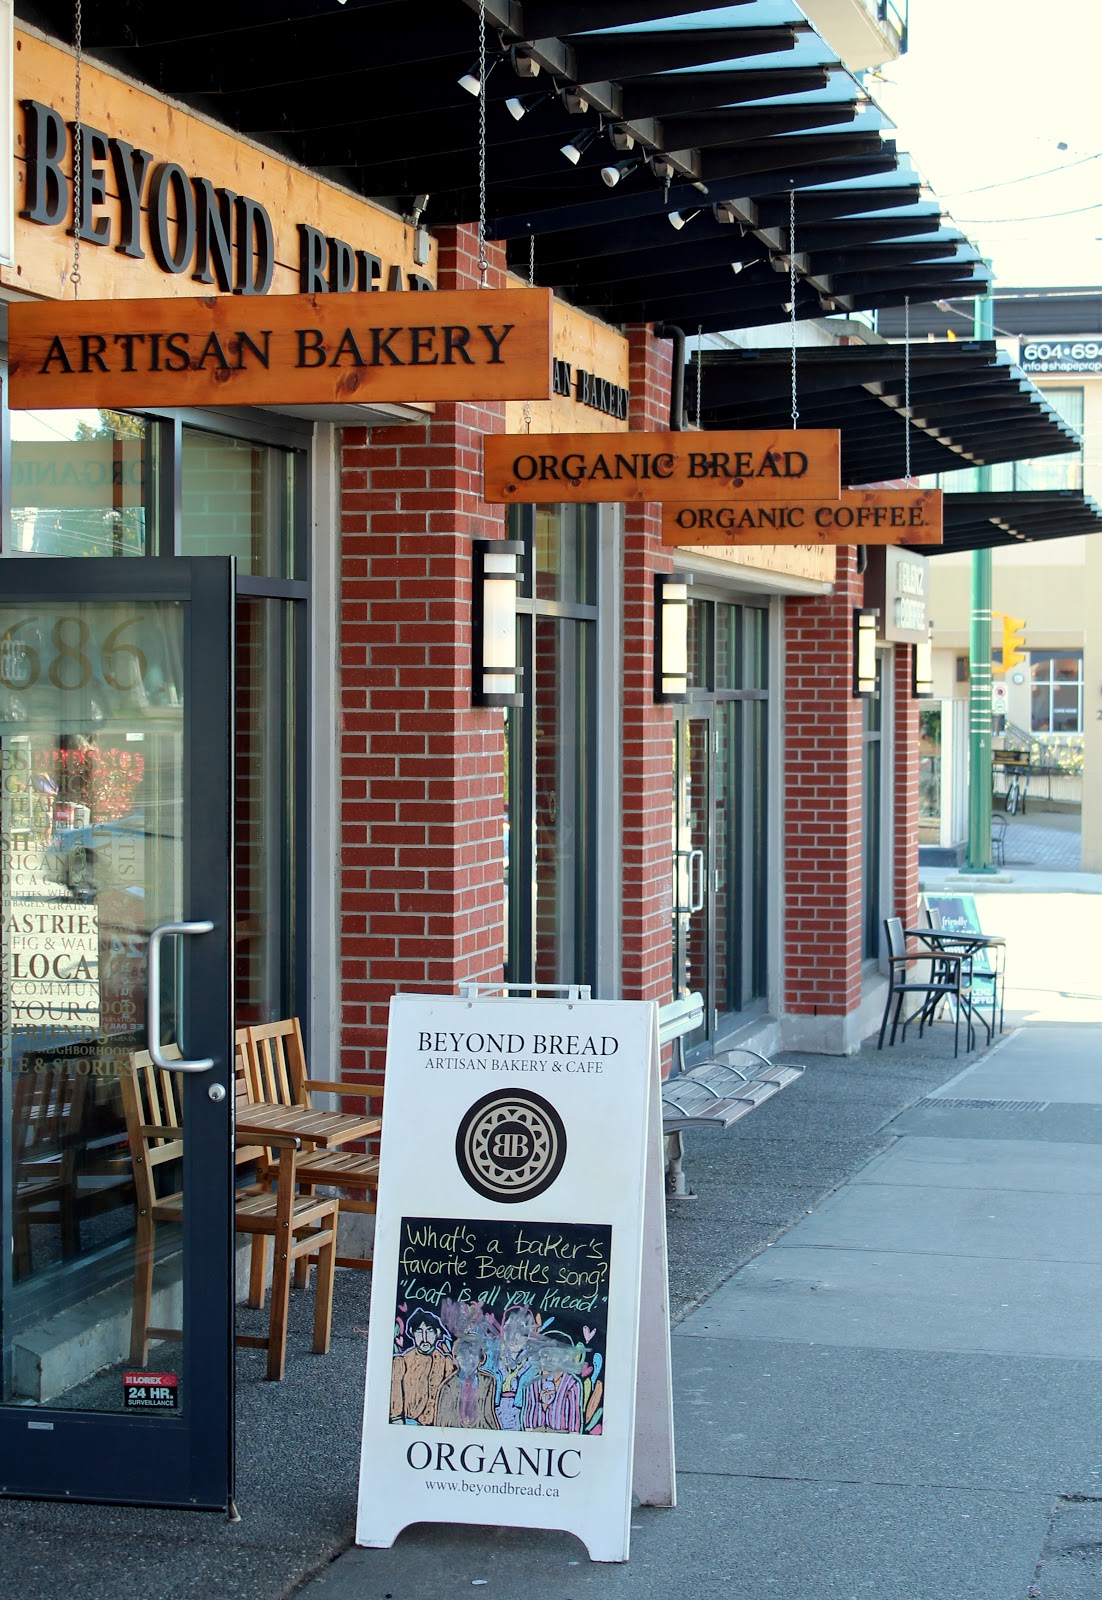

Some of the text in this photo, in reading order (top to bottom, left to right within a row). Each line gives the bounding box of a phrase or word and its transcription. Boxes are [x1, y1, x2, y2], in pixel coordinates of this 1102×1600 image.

[20, 99, 434, 295] BEYOND BRE
[39, 324, 515, 374] ARTISAN BAKERY
[576, 369, 630, 421] BAKERY
[512, 451, 808, 481] ORGANIC BREAD
[678, 505, 925, 529] ORGANIC COFFEE
[13, 936, 38, 950] FIG
[44, 937, 56, 951] &
[11, 1000, 83, 1022] YOUR
[12, 1023, 109, 1045] FRIENDS
[418, 1031, 619, 1056] BEYOND BREAD
[53, 1058, 133, 1077] STORIES
[425, 1057, 603, 1074] ARTISAN BAKERY & CAFE
[406, 1224, 603, 1259] What's a baker's
[400, 1247, 608, 1299] favorite Beatles song?
[457, 1282, 472, 1302] is
[478, 1285, 500, 1307] all
[504, 1290, 536, 1312] you
[133, 1376, 162, 1385] LOREX
[128, 1387, 174, 1399] 24 HR.
[407, 1440, 582, 1479] ORGANIC
[425, 1480, 559, 1498] www.beyondbread.ca
